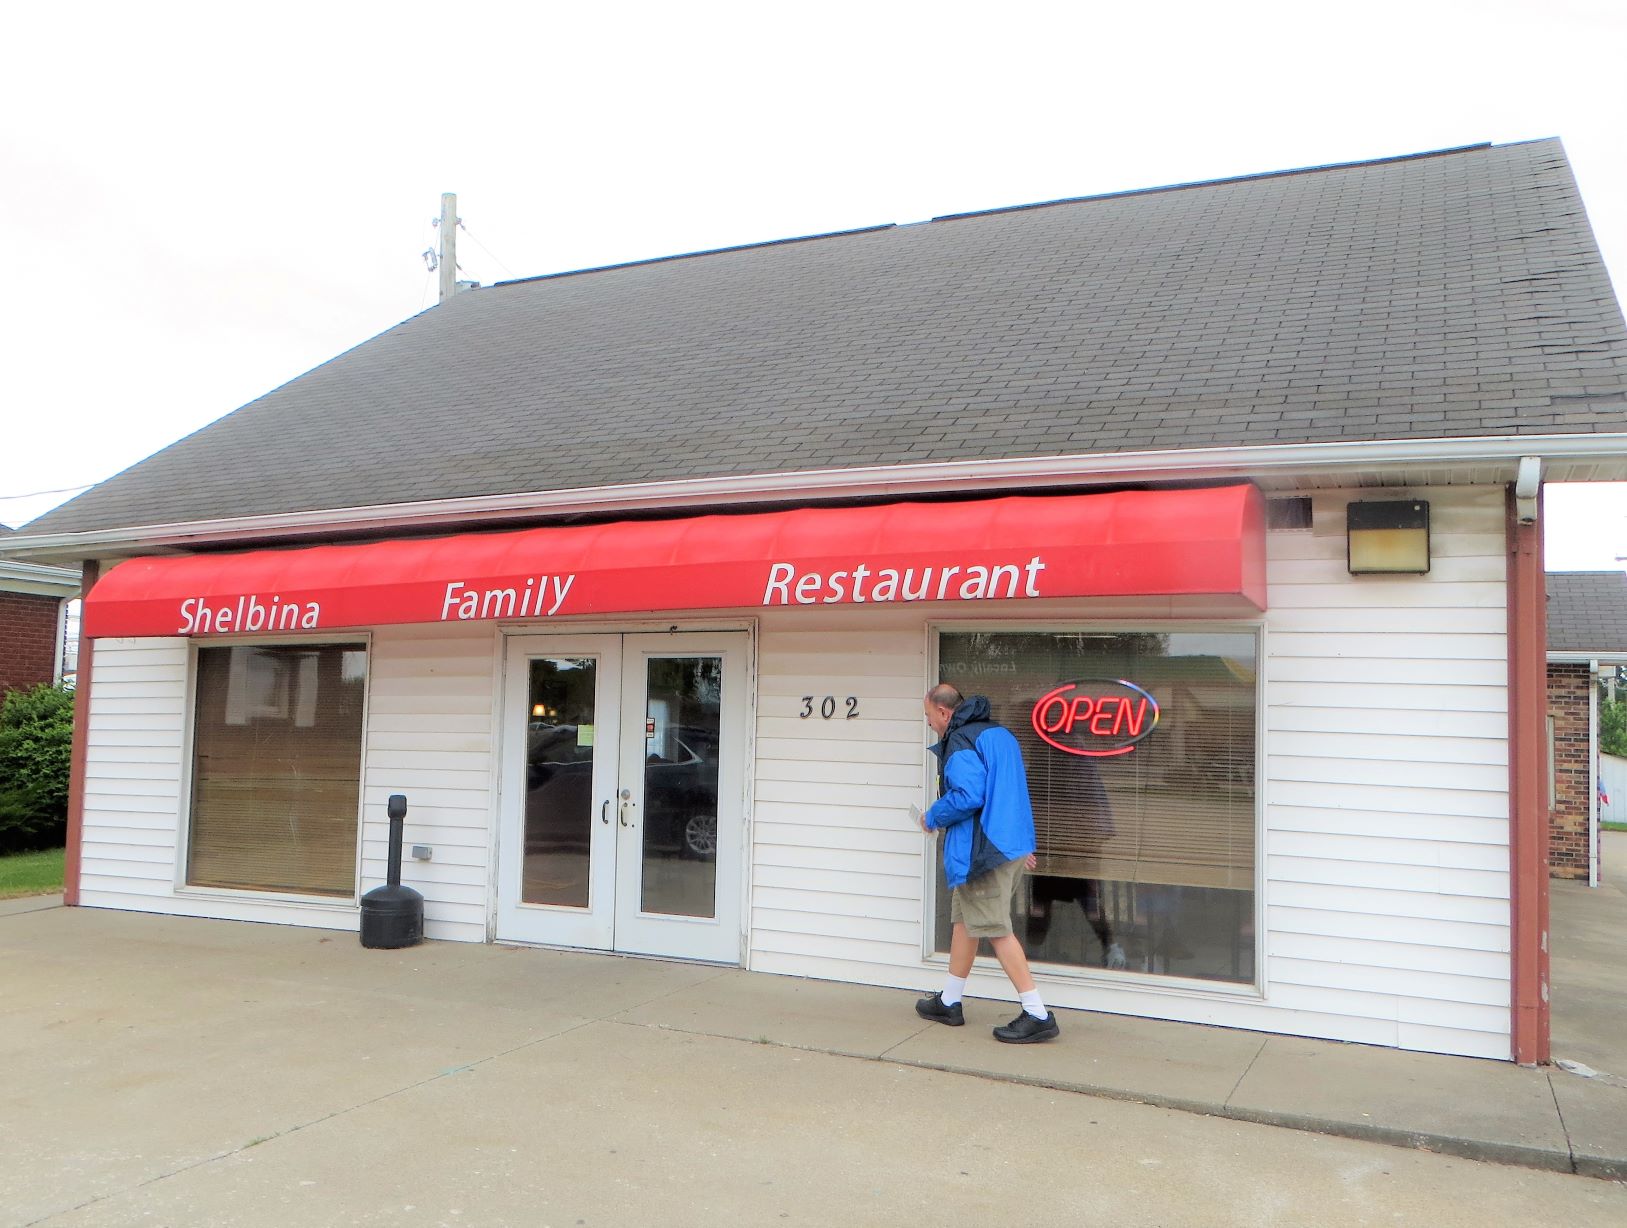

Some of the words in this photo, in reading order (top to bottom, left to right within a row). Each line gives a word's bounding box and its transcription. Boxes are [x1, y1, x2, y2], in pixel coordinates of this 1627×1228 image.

[177, 595, 320, 634] Shelbina
[441, 574, 576, 620] Family
[762, 556, 1046, 605] Restaurant
[800, 696, 860, 720] 302
[1040, 696, 1147, 736] OPEN
